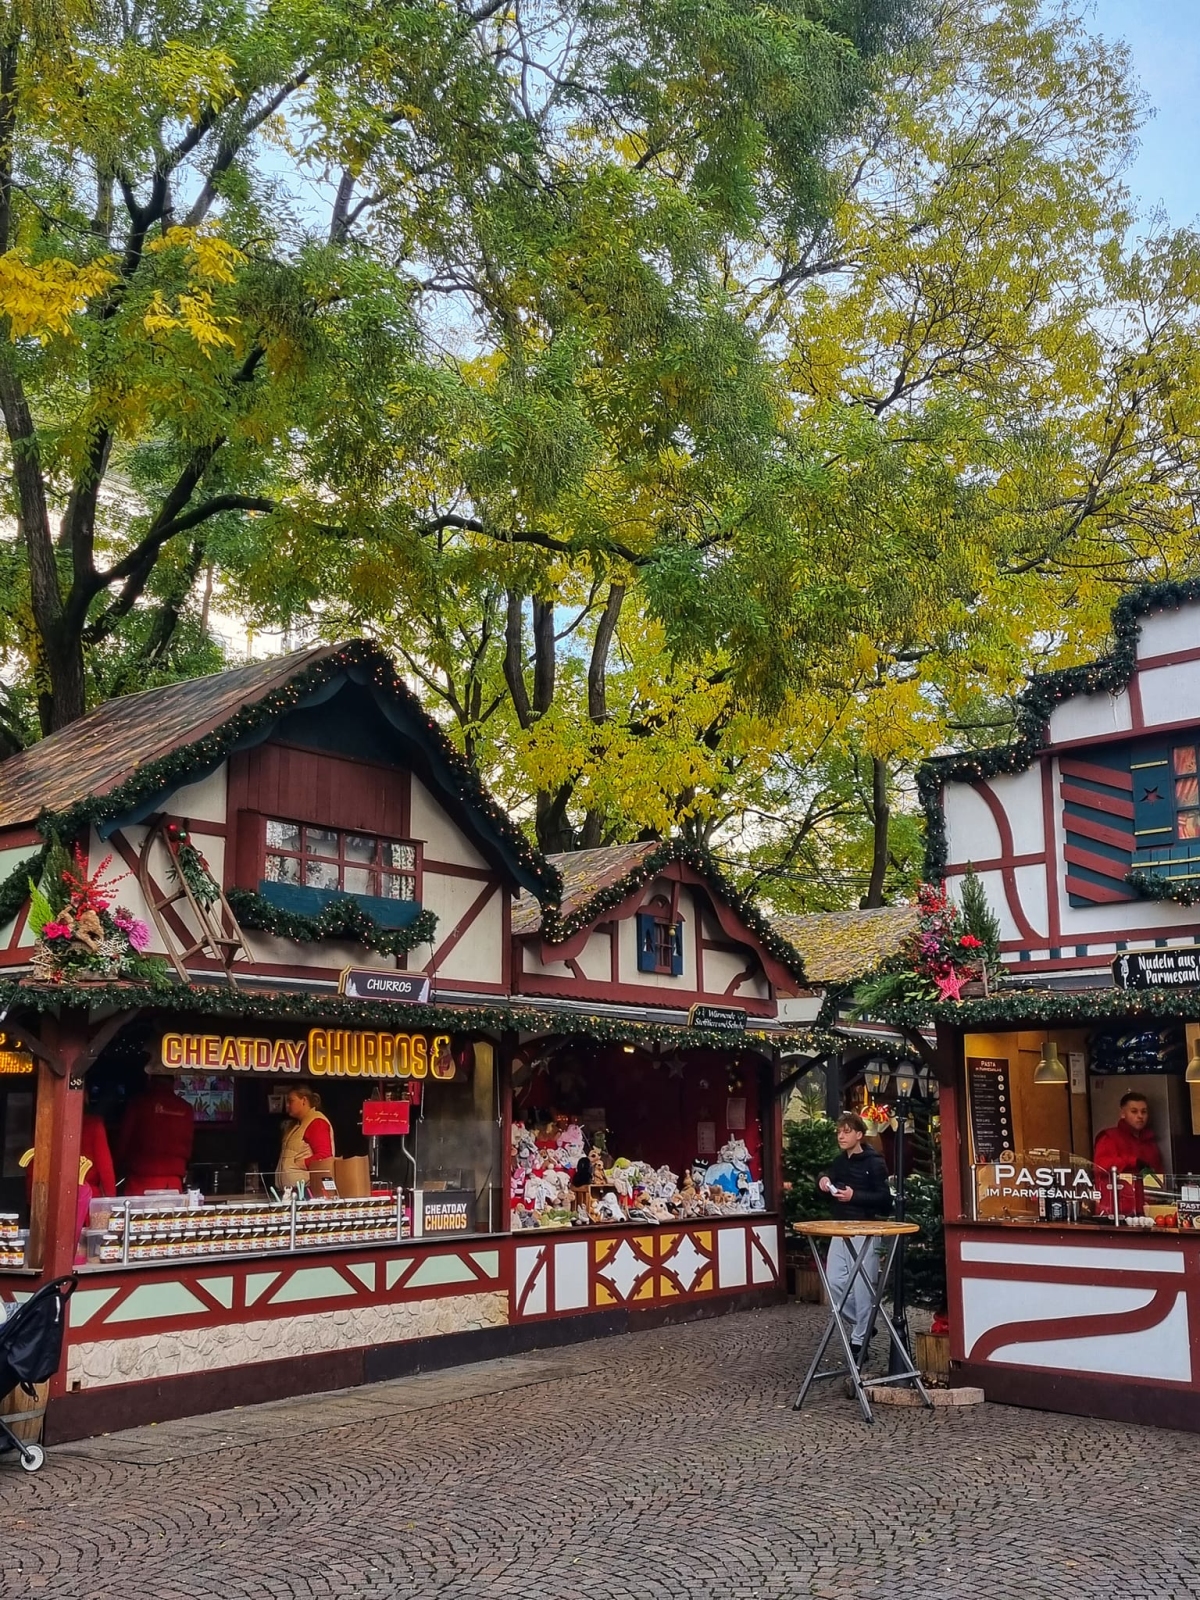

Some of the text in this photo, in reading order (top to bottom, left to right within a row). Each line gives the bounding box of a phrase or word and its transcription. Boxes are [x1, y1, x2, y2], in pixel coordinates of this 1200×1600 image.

[1138, 954, 1196, 970] Nudeln aus
[367, 979, 412, 993] CHURROS
[162, 1028, 428, 1079] CHEATDAY CHURROS
[995, 1164, 1093, 1187] PASTA
[986, 1187, 1102, 1200] IM PARMESANLAIB
[425, 1203, 467, 1215] CHEATDAY
[425, 1213, 467, 1230] CHURROS
